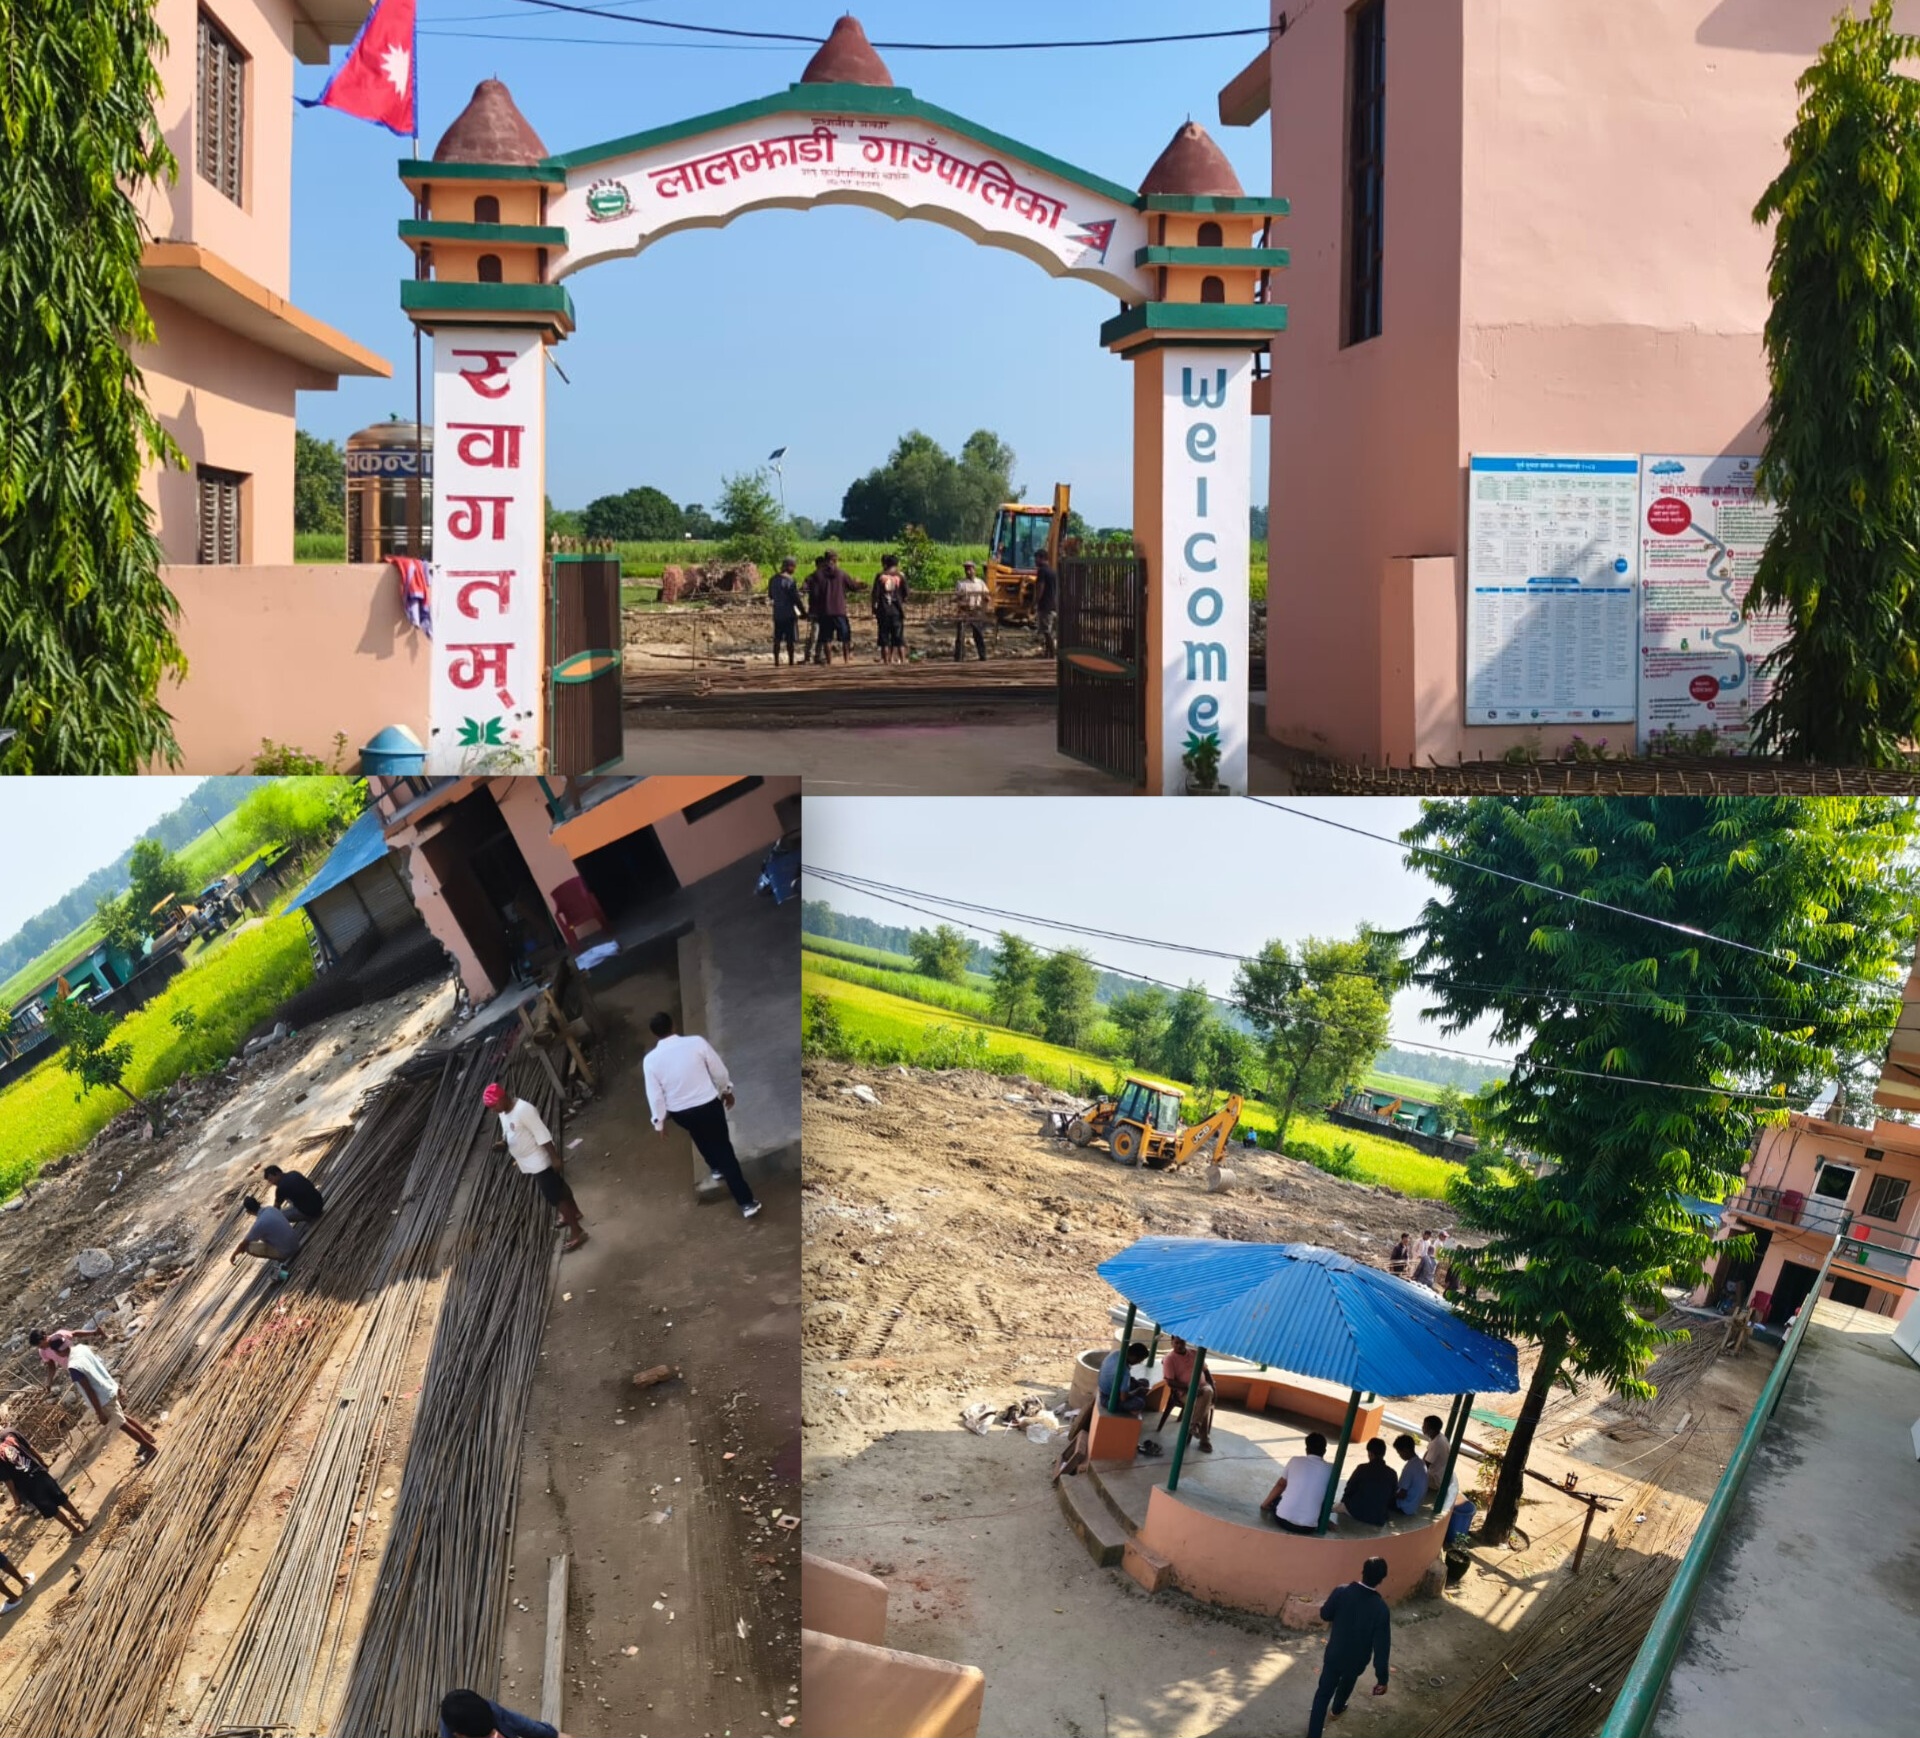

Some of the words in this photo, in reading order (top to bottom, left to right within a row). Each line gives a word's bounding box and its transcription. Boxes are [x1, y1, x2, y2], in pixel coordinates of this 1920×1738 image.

[648, 126, 838, 198] लालझाडी
[858, 135, 1068, 230] गाउँपालिका
[1193, 1125, 1210, 1143] JCB
